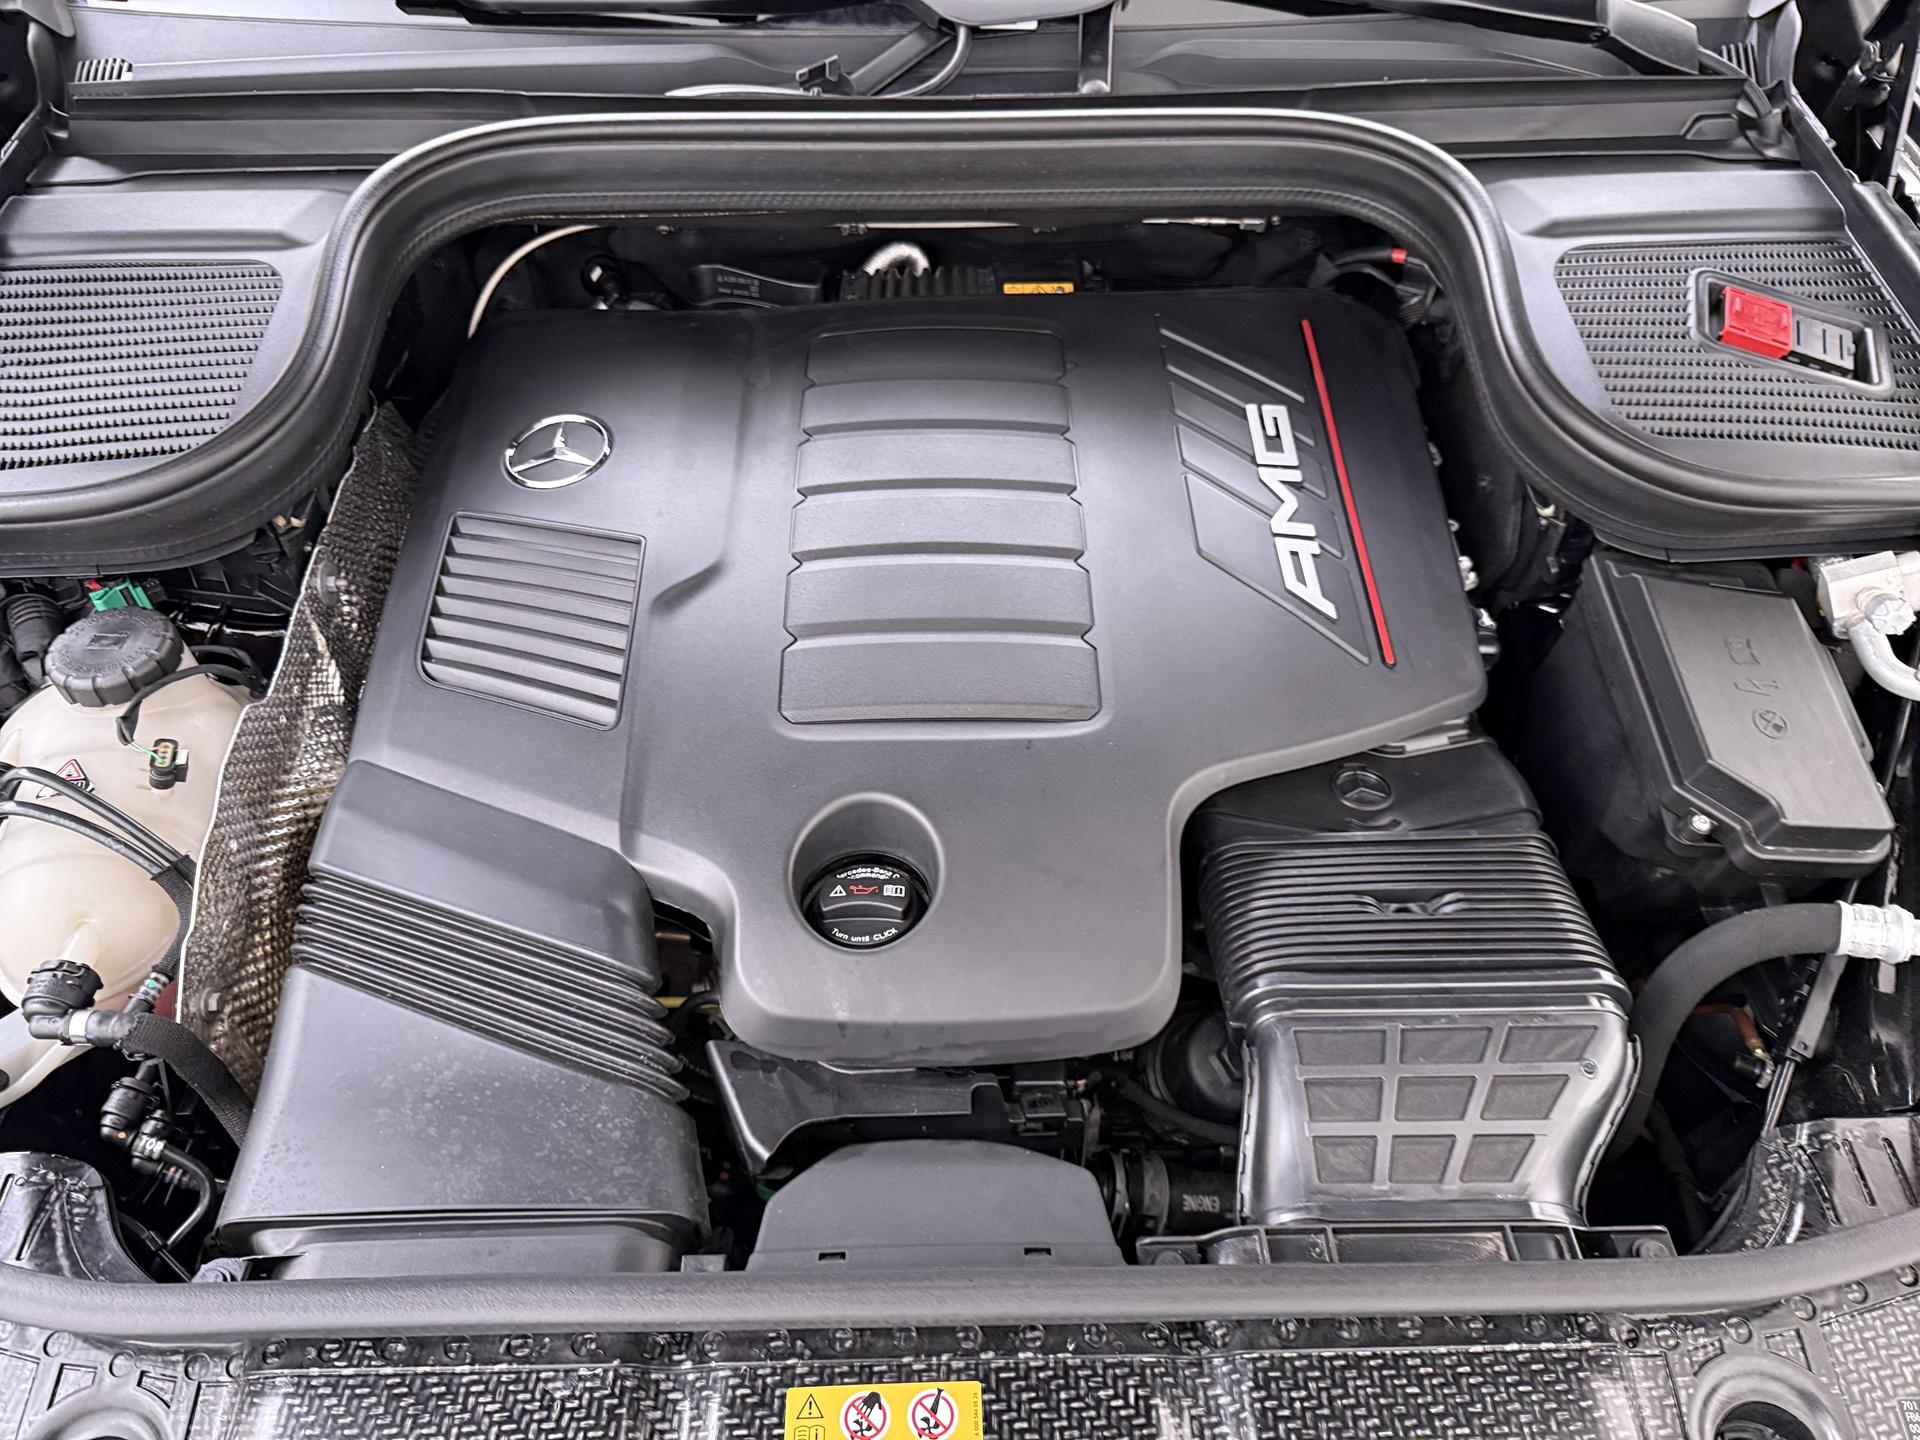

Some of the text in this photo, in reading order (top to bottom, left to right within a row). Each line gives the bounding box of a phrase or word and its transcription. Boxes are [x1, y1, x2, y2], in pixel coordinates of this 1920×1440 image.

[1245, 404, 1338, 619] AMG
[836, 867, 893, 878] ercedes-Benz
[832, 928, 848, 940] Turn
[873, 927, 898, 940] CLICK
[1182, 1194, 1220, 1213] ENGINE
